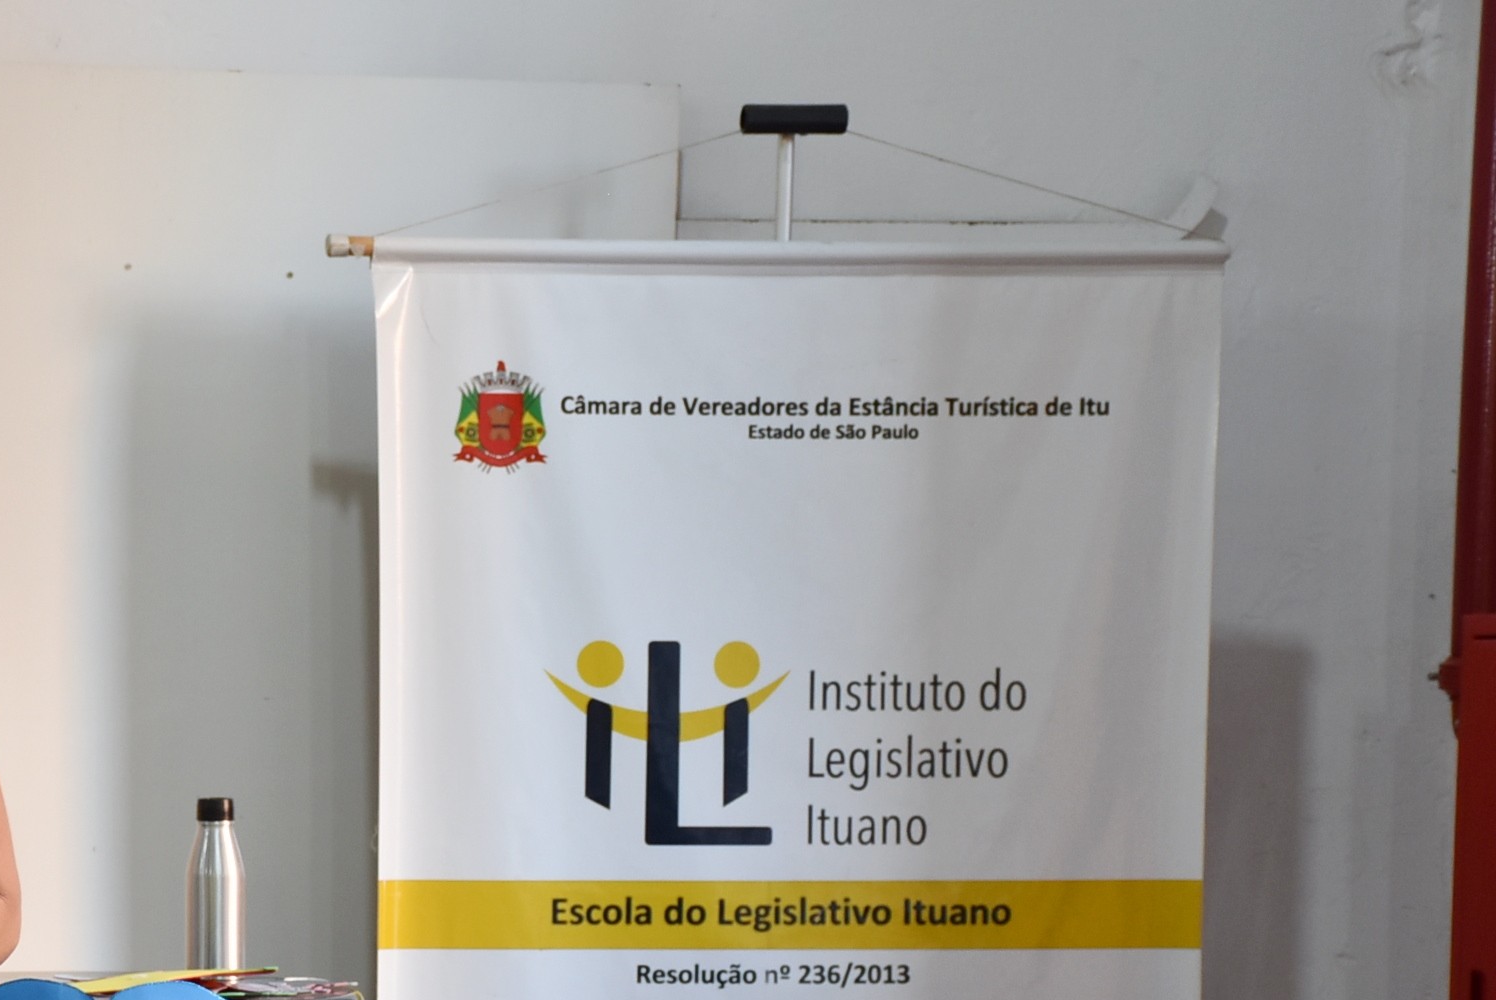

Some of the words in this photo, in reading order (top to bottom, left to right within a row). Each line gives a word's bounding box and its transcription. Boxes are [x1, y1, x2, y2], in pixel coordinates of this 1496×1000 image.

[560, 395, 642, 416] Câmara
[649, 396, 676, 416] de
[682, 396, 809, 417] Vereadores
[815, 396, 842, 417] da
[849, 396, 939, 417] Estância
[944, 396, 1038, 417] Turística
[1045, 396, 1073, 417] de
[1079, 398, 1110, 417] Itu
[748, 424, 805, 440] Estado
[809, 424, 831, 440] de
[835, 424, 866, 440] São
[871, 424, 919, 440] Paulo
[808, 669, 966, 712] Instituto
[979, 667, 1027, 712] do
[807, 735, 1009, 791] Legislativo
[806, 804, 927, 846] Ituano
[551, 896, 653, 926] Escola
[663, 896, 707, 926] do
[717, 896, 892, 932] Legislativo
[903, 898, 1012, 927] Ituano
[635, 964, 757, 989] Resolução
[764, 964, 791, 985] nº
[797, 962, 911, 989] 236/2013
